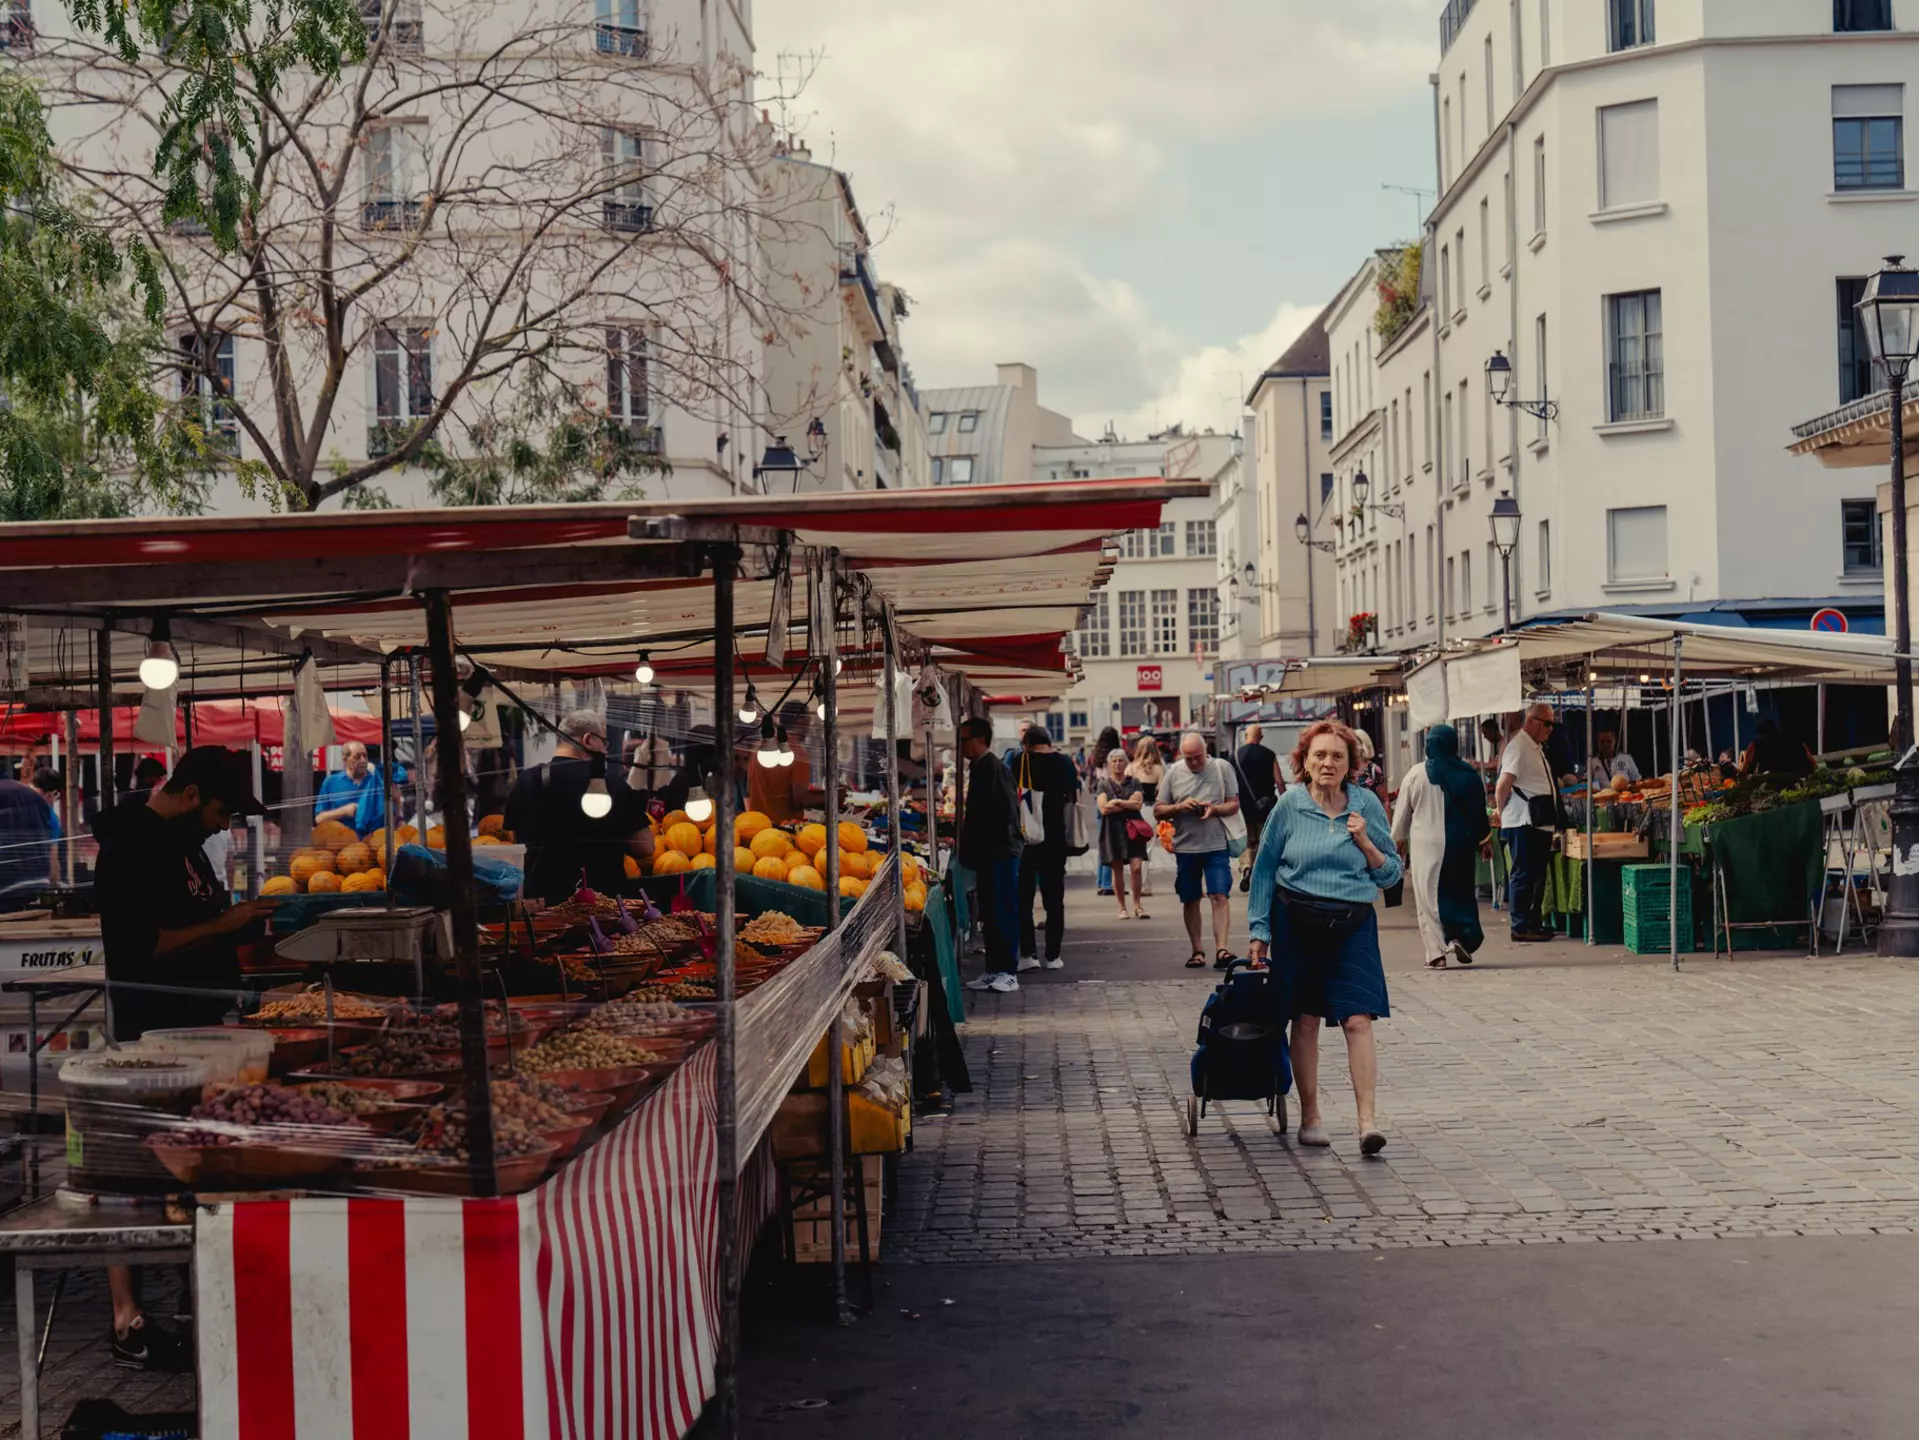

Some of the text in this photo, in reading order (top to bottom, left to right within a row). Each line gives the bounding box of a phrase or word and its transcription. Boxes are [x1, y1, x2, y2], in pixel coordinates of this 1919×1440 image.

[1137, 670, 1161, 681] 100
[21, 950, 93, 967] FRUTAS Y
